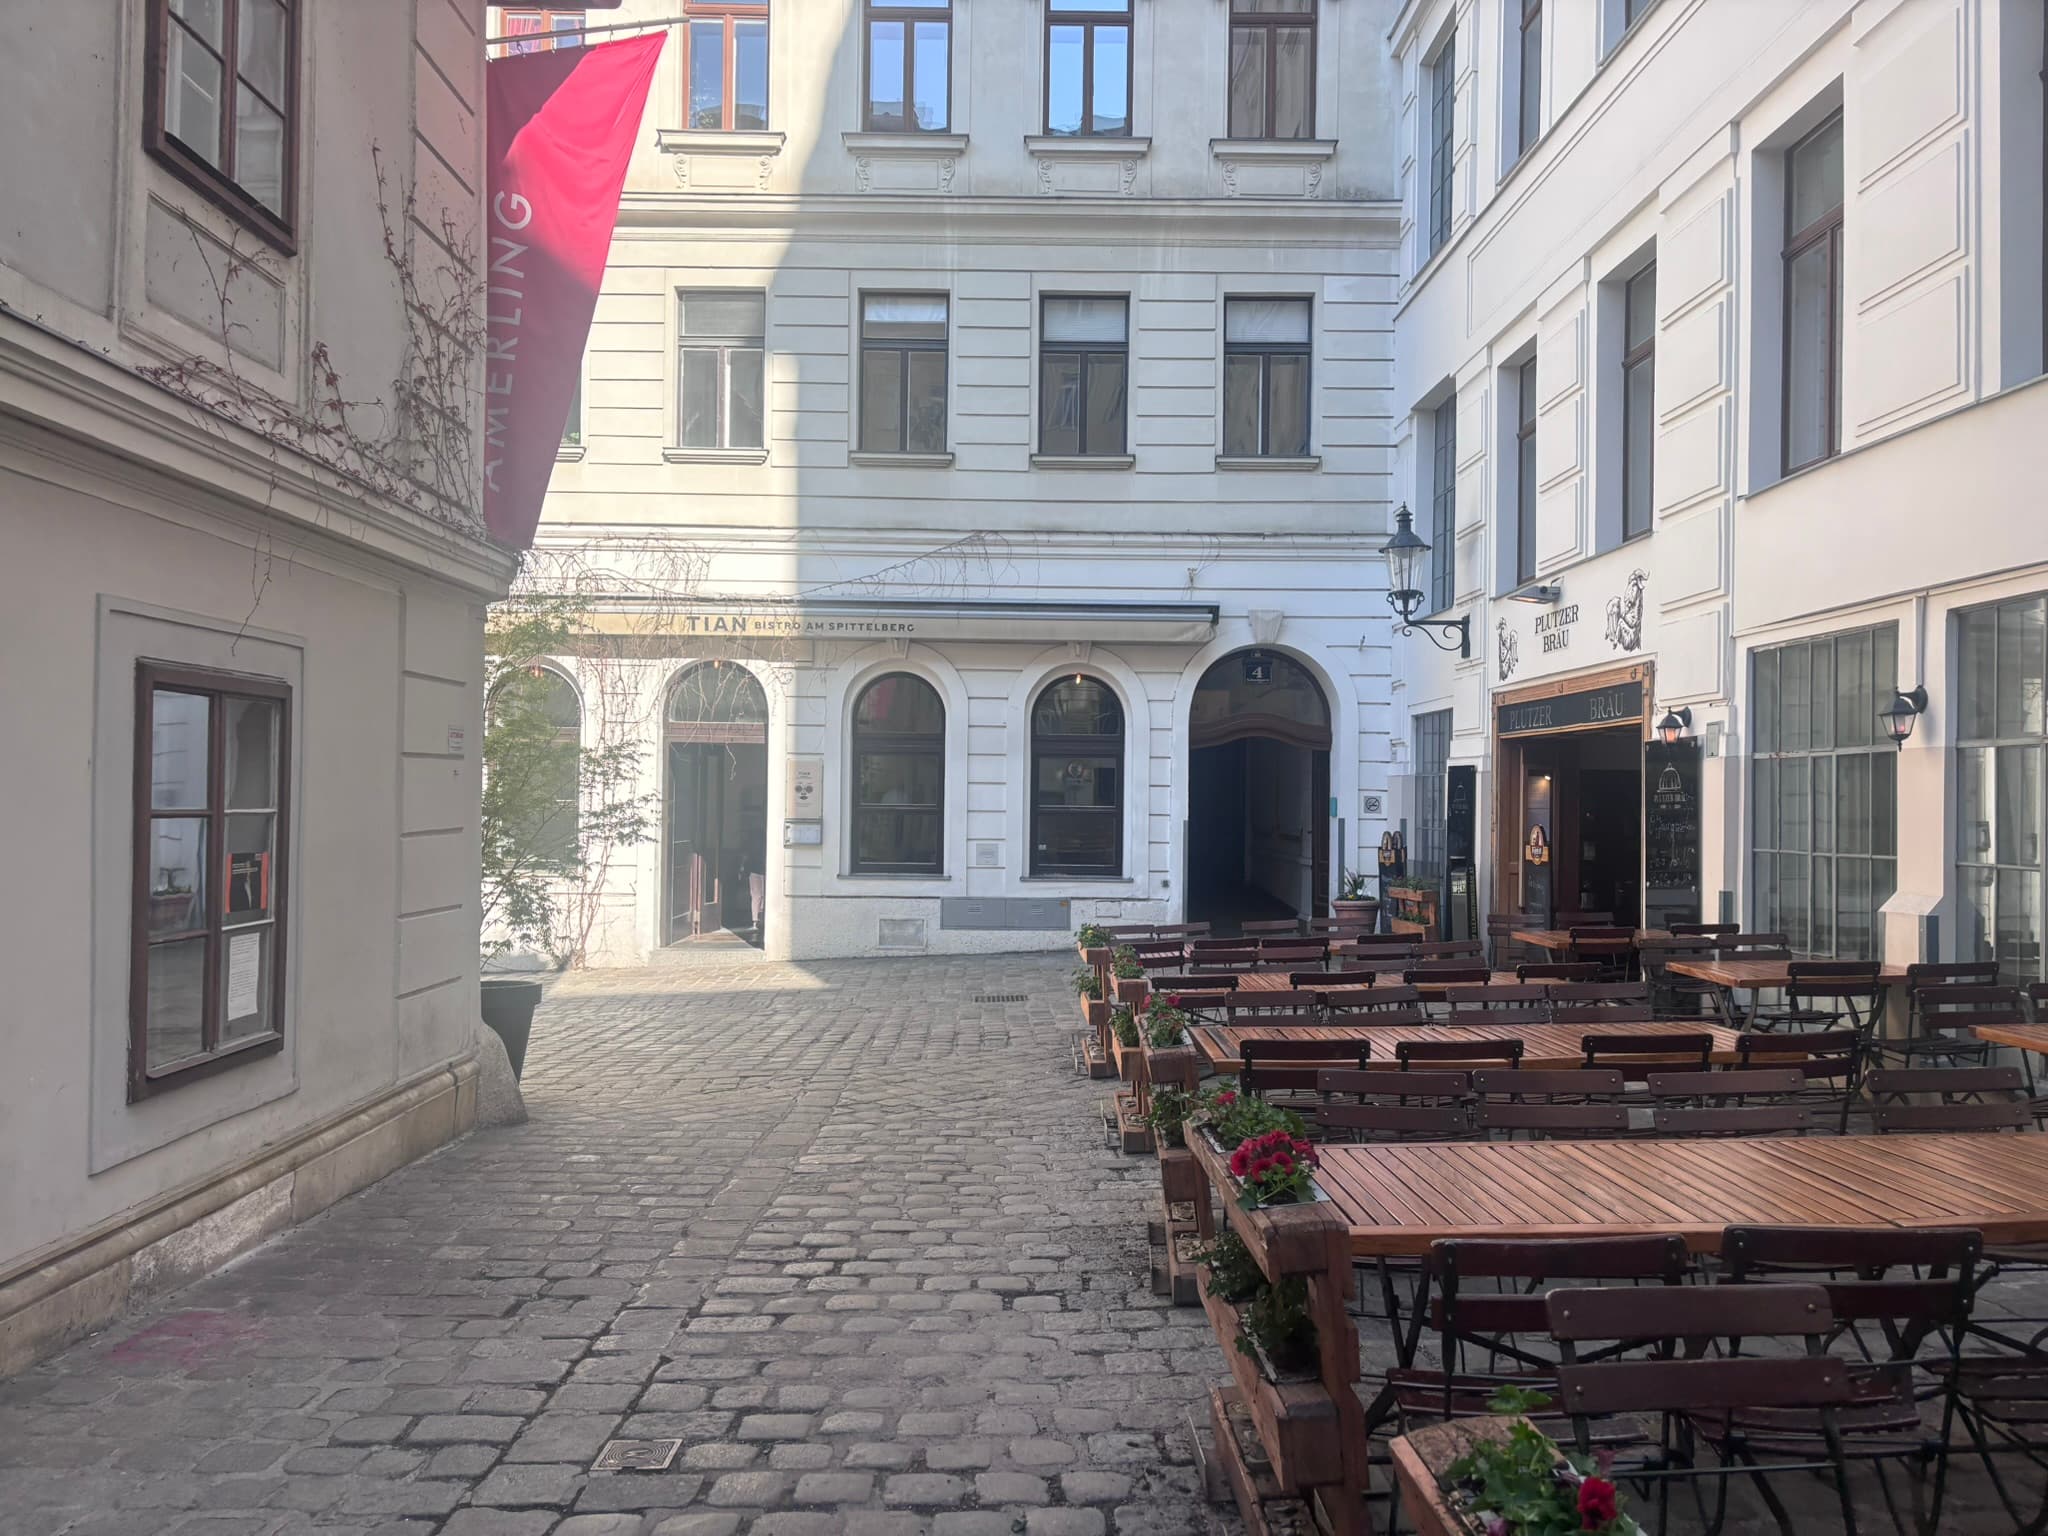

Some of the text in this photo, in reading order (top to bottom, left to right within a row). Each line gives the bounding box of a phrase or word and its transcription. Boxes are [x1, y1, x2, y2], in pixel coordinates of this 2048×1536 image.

[484, 190, 533, 493] AMERLING
[686, 615, 916, 632] TIAN BISTRO AM SPITTELBERG
[1534, 604, 1580, 634] PLUTZER
[1543, 628, 1570, 653] BRÄU
[1251, 666, 1263, 679] 4
[1509, 690, 1625, 730] PLUTZER BRÄU
